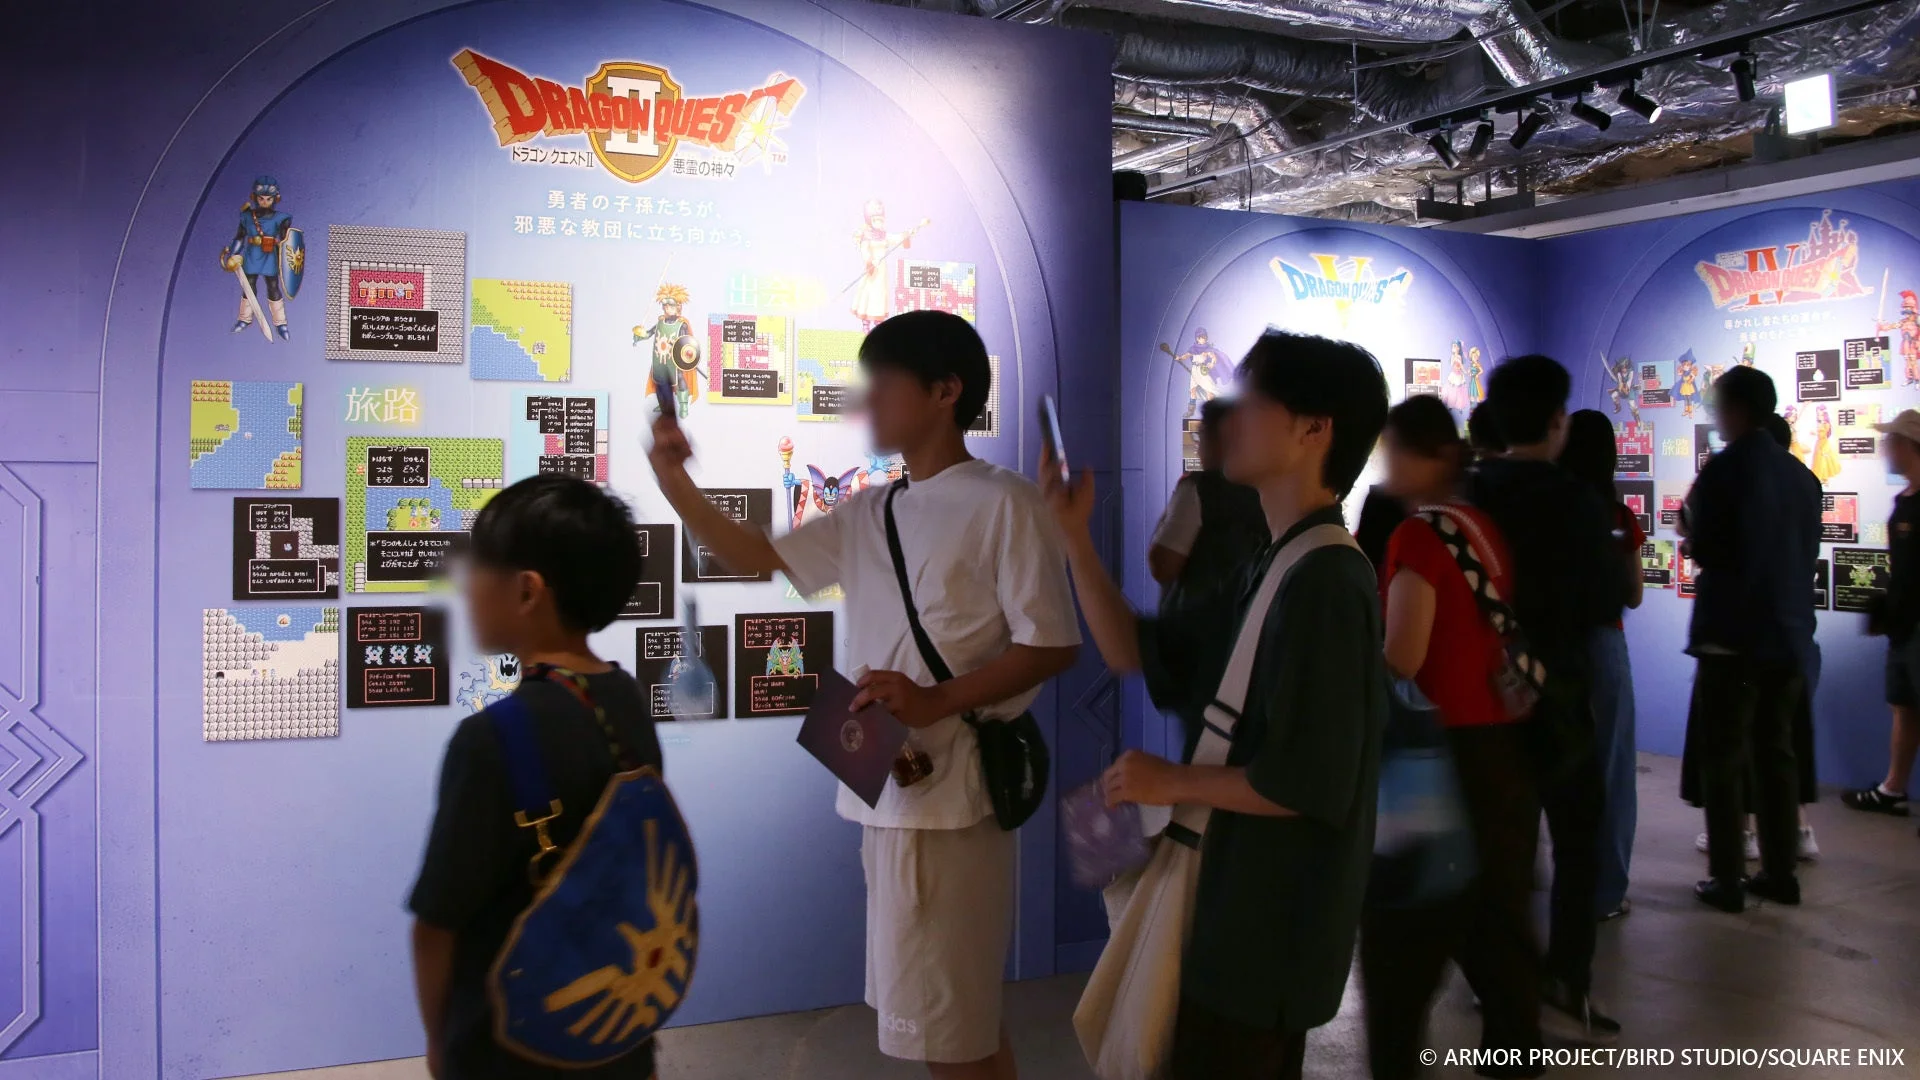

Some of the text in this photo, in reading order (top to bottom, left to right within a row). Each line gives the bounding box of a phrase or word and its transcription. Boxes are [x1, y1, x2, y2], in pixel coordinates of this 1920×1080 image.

[452, 48, 651, 147] DRAGON
[672, 157, 736, 178] 悪霊の神々
[547, 189, 722, 218] 勇者の子孫たちが、
[513, 214, 753, 248] 邪悪な教団に立ち向かう。
[1272, 257, 1350, 301] DRAGON
[1697, 260, 1779, 307] DRAGON
[344, 386, 419, 424] 旅路
[376, 455, 393, 463] はなす
[402, 464, 421, 474] どうぐ
[375, 475, 425, 484] そうび しらべる
